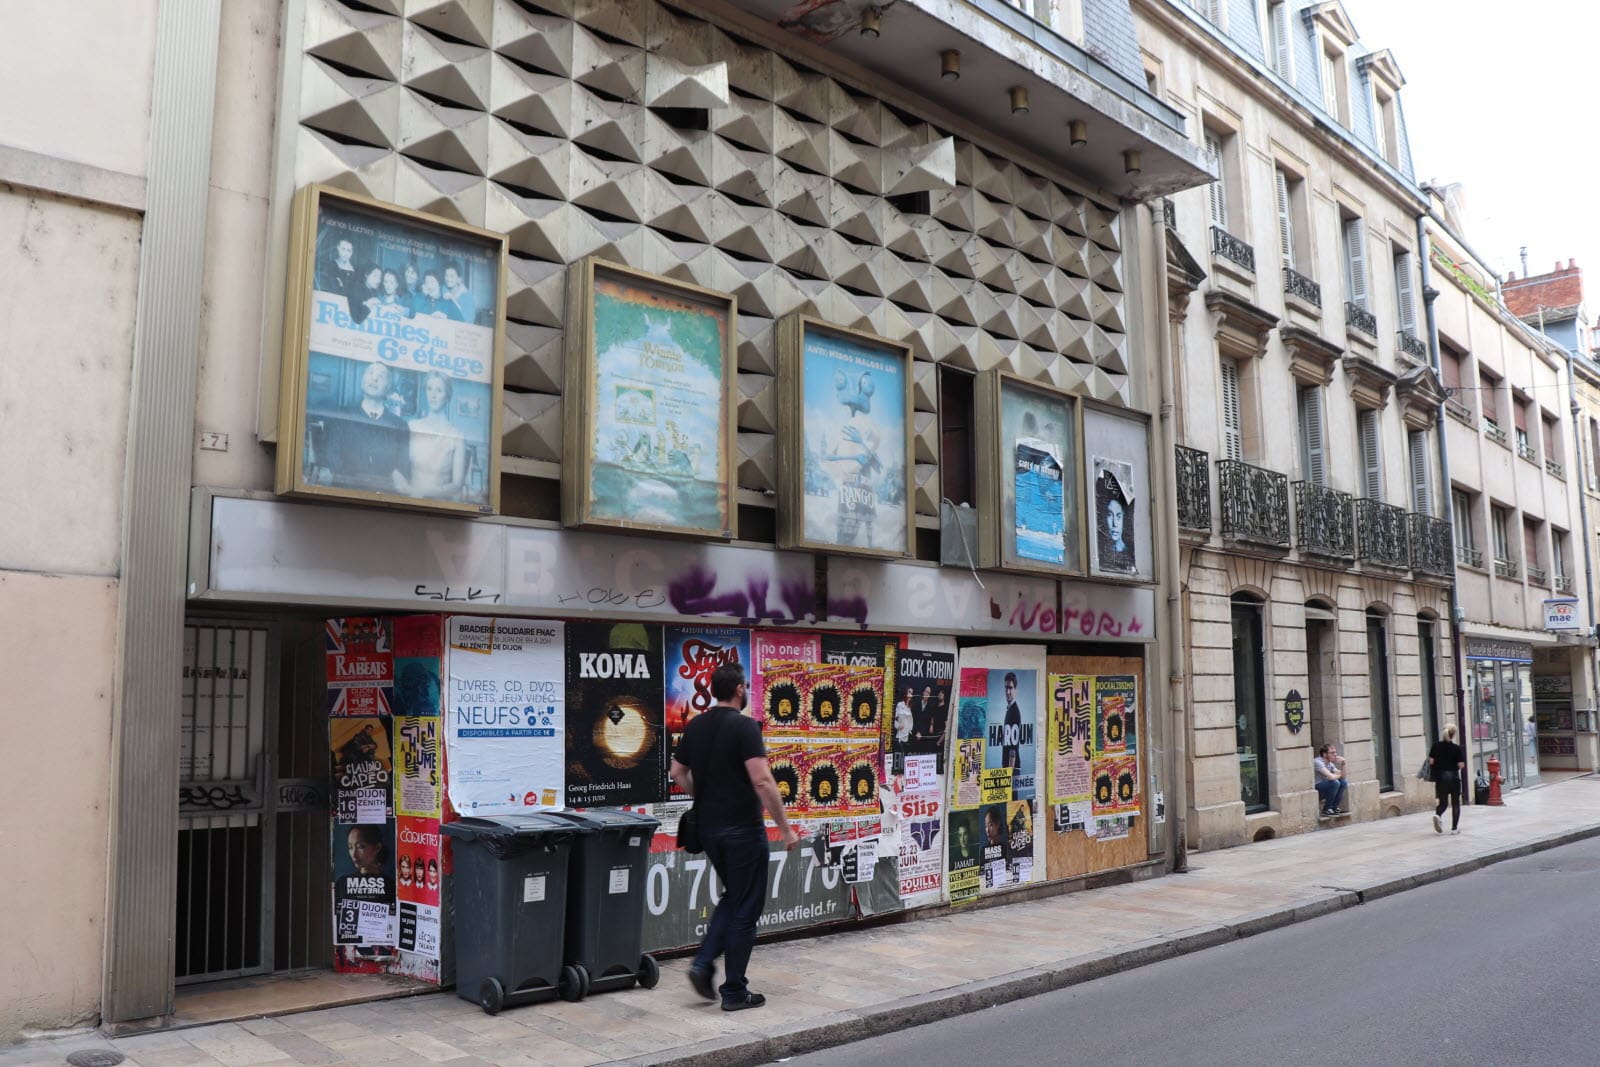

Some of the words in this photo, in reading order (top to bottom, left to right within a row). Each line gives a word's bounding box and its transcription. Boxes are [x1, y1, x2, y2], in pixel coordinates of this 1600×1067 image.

[376, 306, 401, 321] Les
[315, 300, 431, 345] Femmes
[431, 335, 448, 349] du
[413, 344, 484, 377] étage
[839, 485, 874, 510] RANGO
[1549, 614, 1571, 622] mae
[459, 624, 496, 635] BRADERIE
[497, 626, 535, 637] SOLIDAIRE
[535, 628, 556, 637] FNAC
[459, 634, 491, 643] DIMANCH
[761, 644, 775, 653] no
[779, 645, 800, 655] one
[803, 642, 812, 656] is
[335, 655, 388, 679] RABEATS
[579, 652, 650, 679] KOMA
[900, 657, 924, 678] COCK
[927, 660, 954, 680] ROBIN
[457, 679, 499, 694] LIVRES,
[504, 680, 524, 694] CD,
[529, 681, 556, 694] DVD,
[458, 692, 497, 704] JOUETS,
[500, 693, 523, 703] JEUX
[457, 706, 521, 725] NEUFS
[462, 729, 504, 737] DISPONIBLES
[511, 728, 532, 737] PARTIR
[533, 729, 542, 737] DE
[989, 723, 1034, 748] HAROUN
[990, 769, 1008, 777] HAROUN
[568, 784, 588, 793] Georg
[588, 782, 616, 791] Friedrich
[617, 781, 632, 790] Haas
[338, 790, 358, 799] SAM
[357, 789, 386, 798] DIJON
[569, 796, 576, 804] 14
[584, 795, 591, 803] 15
[340, 800, 356, 812] 16
[902, 800, 939, 818] Slip
[899, 846, 907, 856] 22
[909, 845, 918, 855] 23
[985, 845, 1001, 853] MASS
[899, 855, 918, 867] JUIN
[954, 858, 975, 870] JAMAIT
[346, 877, 385, 888] MASS
[900, 874, 940, 891] POUILLY
[340, 899, 360, 909] JEU
[361, 903, 388, 914] DIJON
[345, 911, 355, 923] 3
